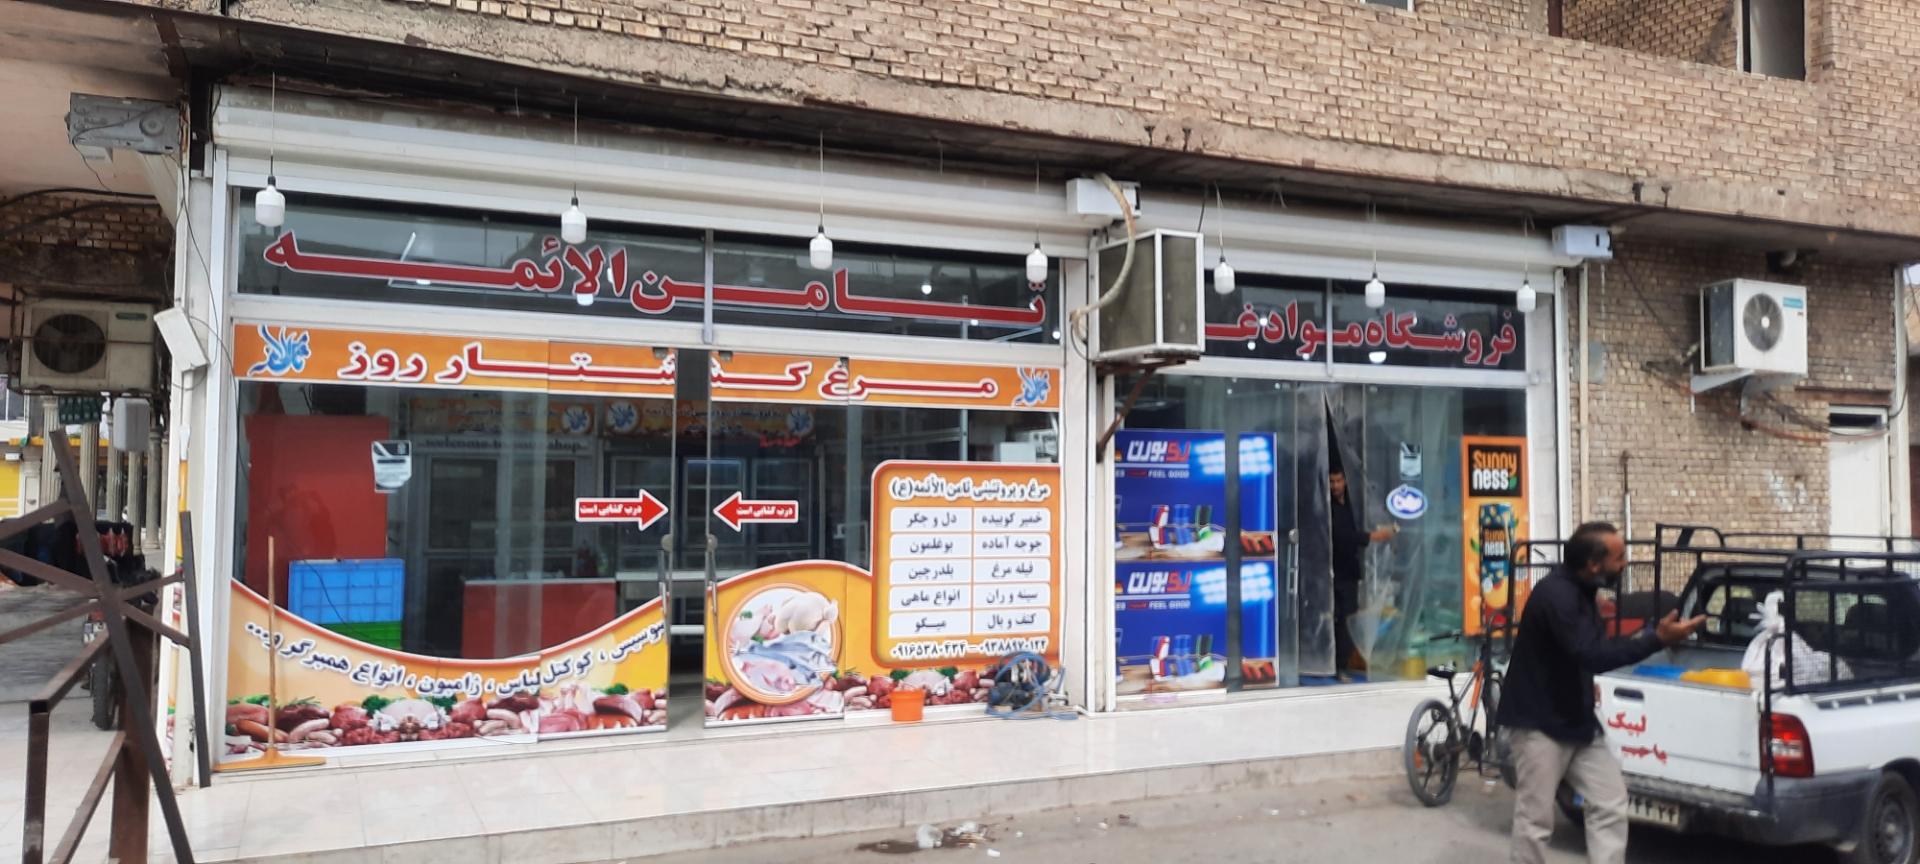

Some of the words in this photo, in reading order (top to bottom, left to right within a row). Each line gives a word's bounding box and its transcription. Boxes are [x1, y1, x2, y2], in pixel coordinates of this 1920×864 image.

[337, 340, 427, 382] روز
[819, 360, 999, 401] مرغ
[942, 511, 957, 527] دل
[982, 535, 1009, 550] آماده
[1014, 538, 1042, 554] جوجه
[908, 563, 954, 580] بلدرچین
[991, 562, 1012, 578] مرغ
[1015, 560, 1033, 577] فیله
[901, 590, 930, 606] ماهی
[933, 588, 961, 606] انواع
[986, 588, 1004, 604] ران
[987, 613, 1004, 629] بال
[352, 663, 402, 687] انواع
